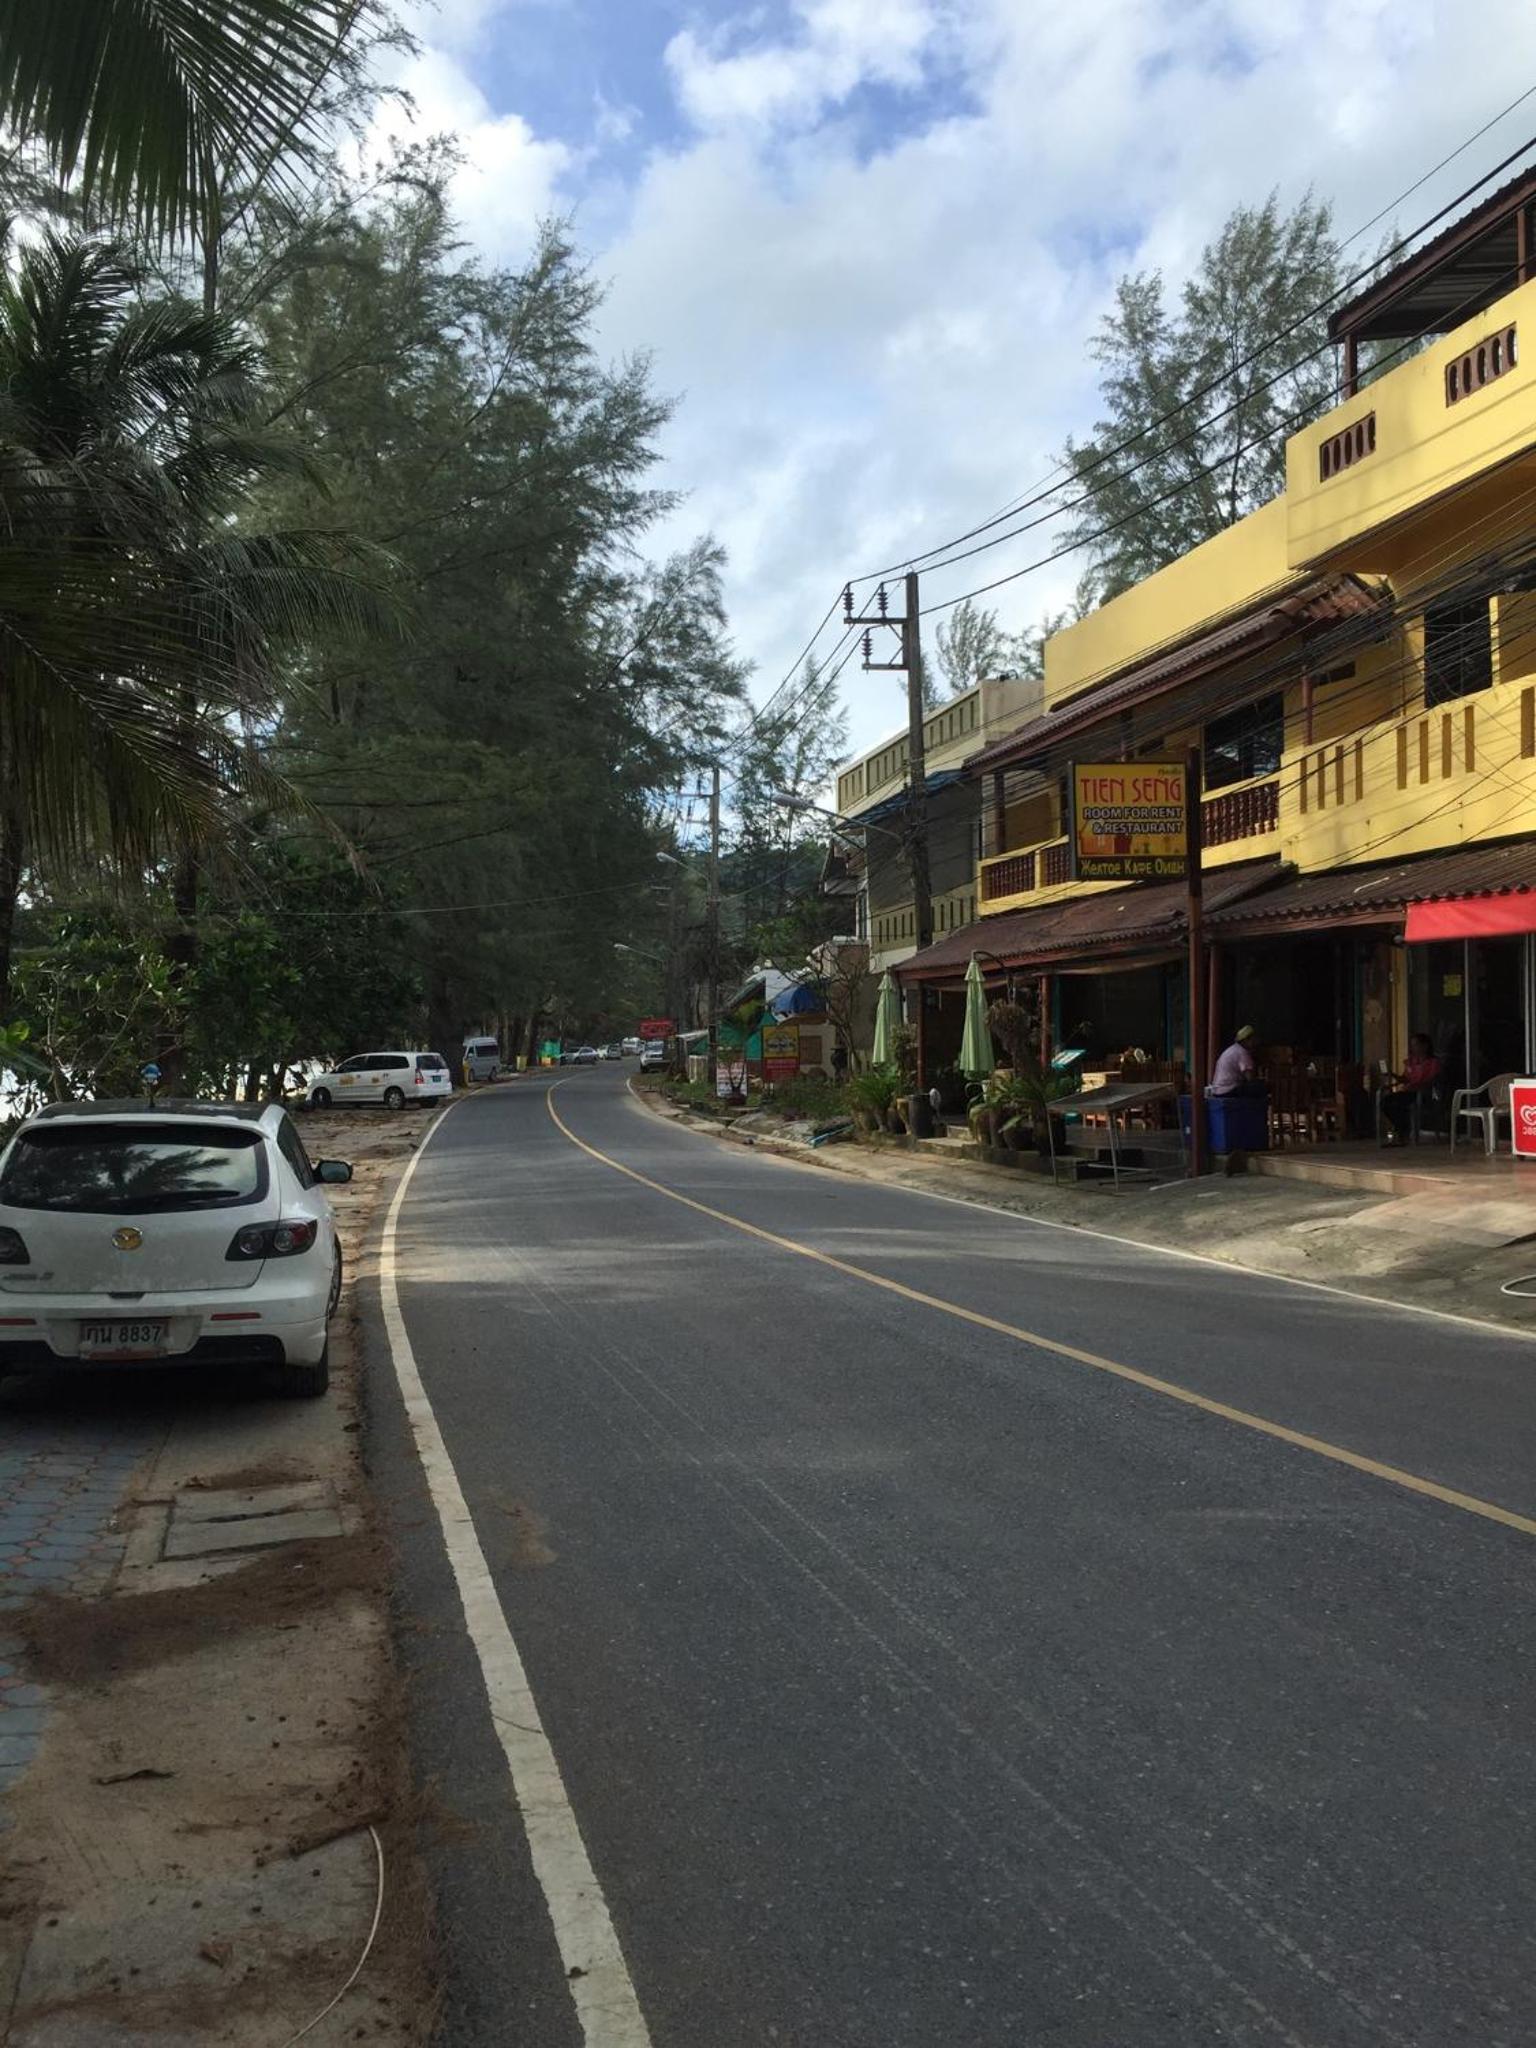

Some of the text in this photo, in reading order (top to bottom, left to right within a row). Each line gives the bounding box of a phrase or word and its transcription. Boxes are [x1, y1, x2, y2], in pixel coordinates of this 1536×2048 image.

[1081, 777, 1181, 803] TIEN SENG
[1084, 807, 1182, 819] ROOM FOR RENT
[1093, 822, 1182, 834] & RESTAURANT
[118, 1325, 163, 1344] 8837
